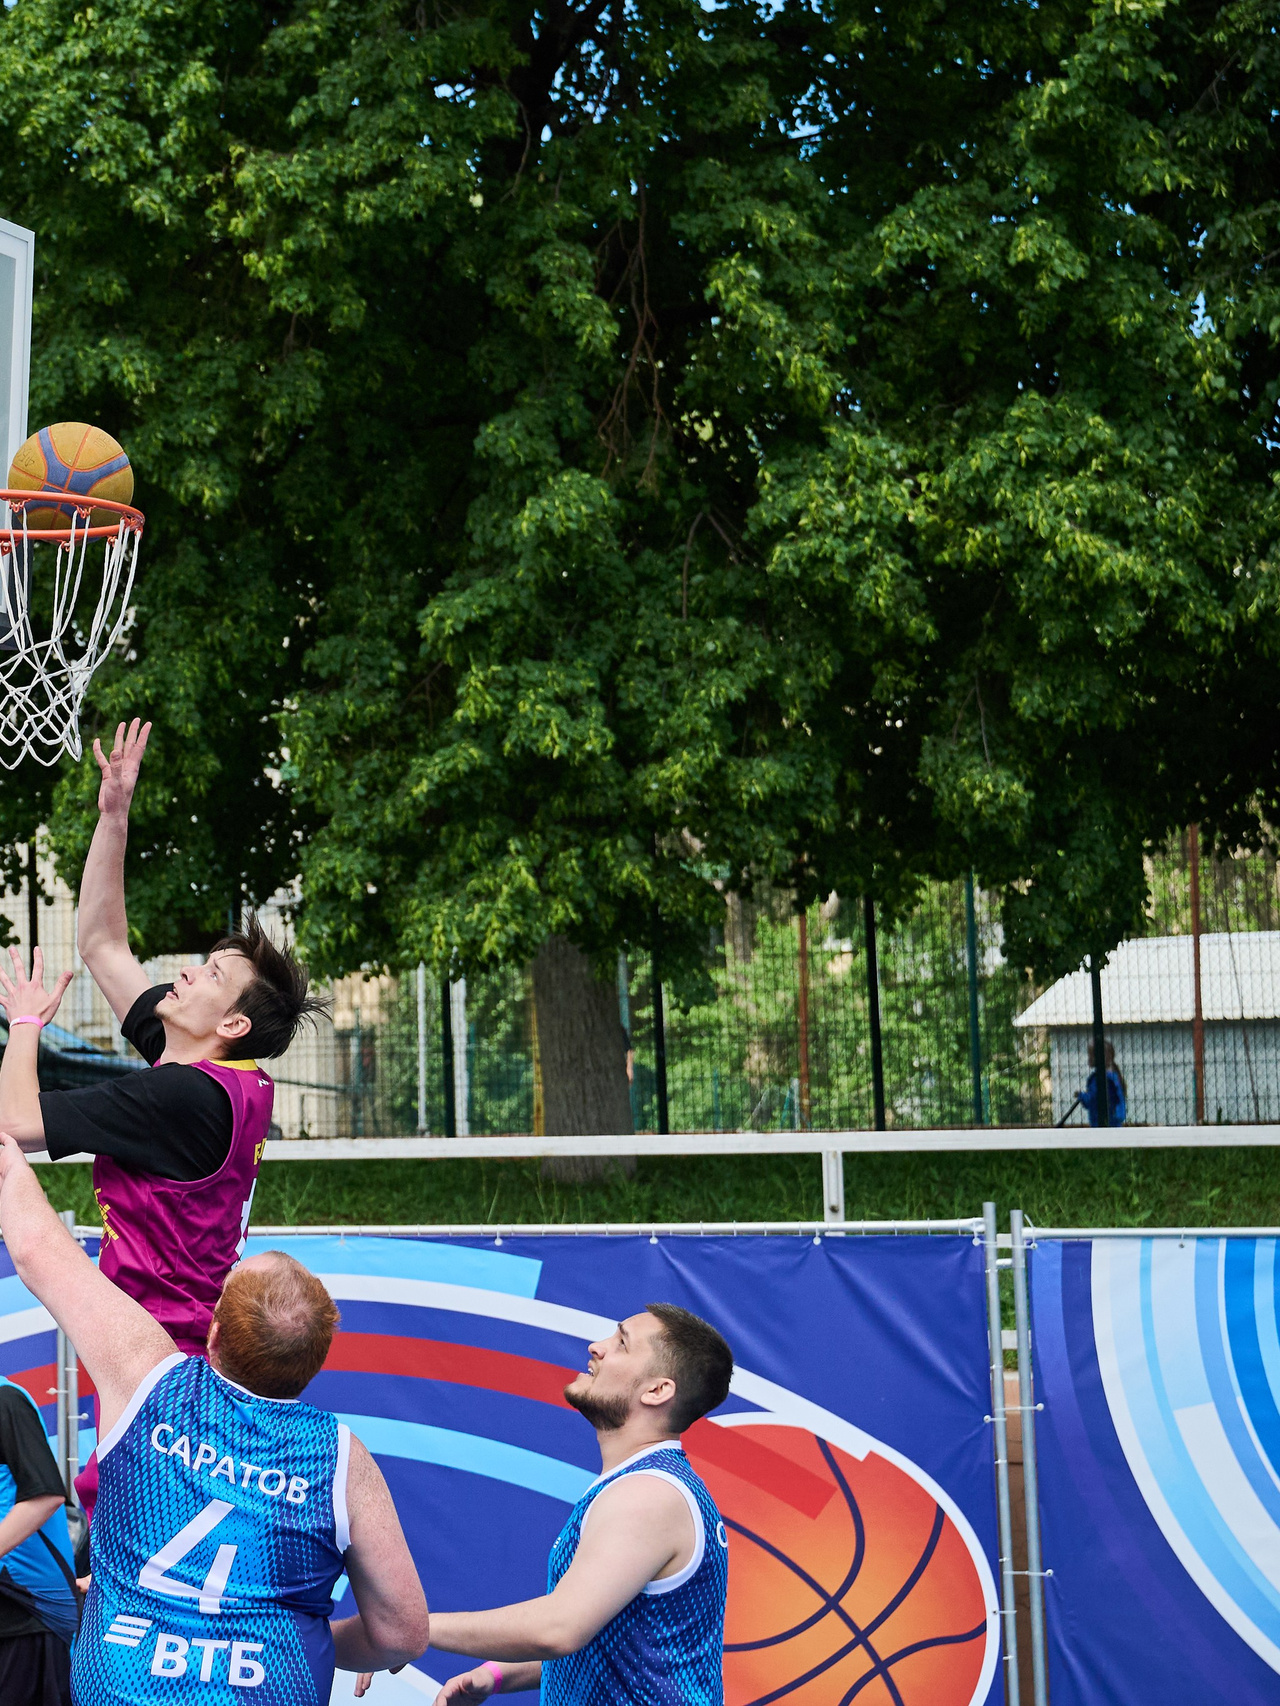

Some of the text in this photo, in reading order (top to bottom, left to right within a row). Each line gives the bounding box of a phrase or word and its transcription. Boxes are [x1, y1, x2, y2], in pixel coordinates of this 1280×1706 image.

[150, 1423, 310, 1504] САРАТОВ
[138, 1498, 238, 1614] 4
[150, 1634, 265, 1687] ВТБ
